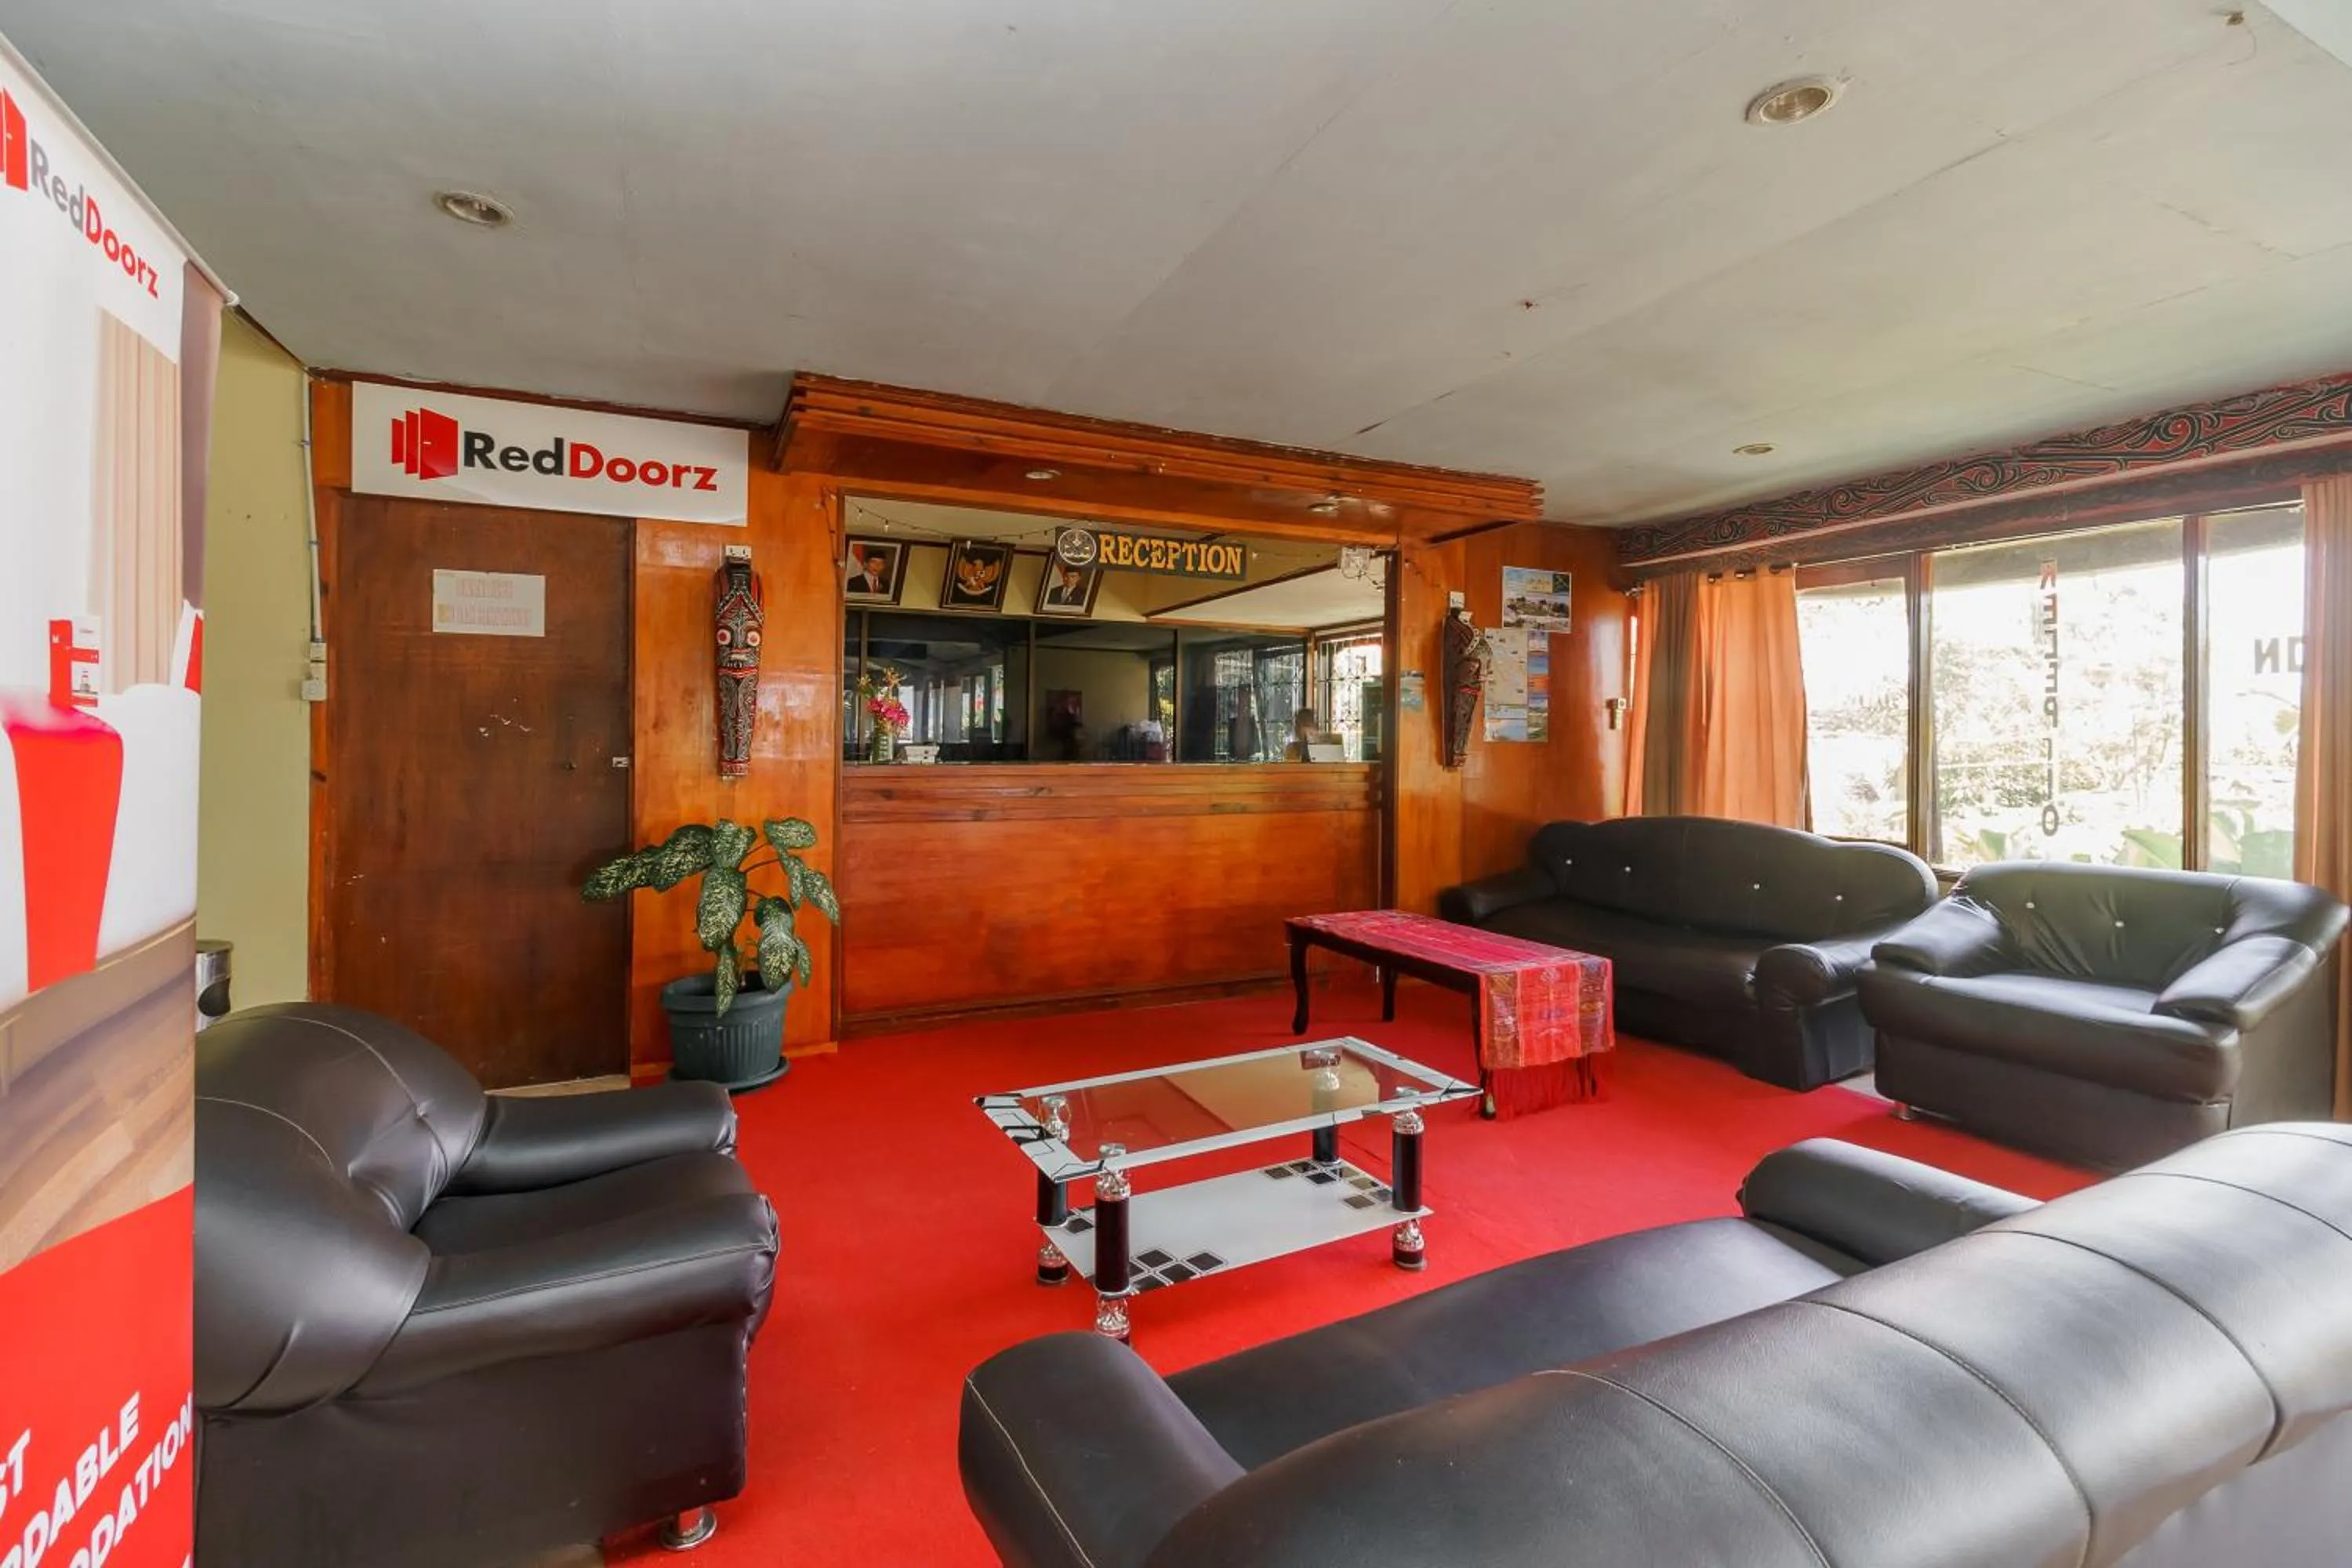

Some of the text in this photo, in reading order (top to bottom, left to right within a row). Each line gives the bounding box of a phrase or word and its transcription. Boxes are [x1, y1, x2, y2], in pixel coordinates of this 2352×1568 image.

[31, 138, 158, 298] RedDoorz
[464, 430, 717, 492] RedDoorz
[1098, 534, 1243, 575] RECEPTION
